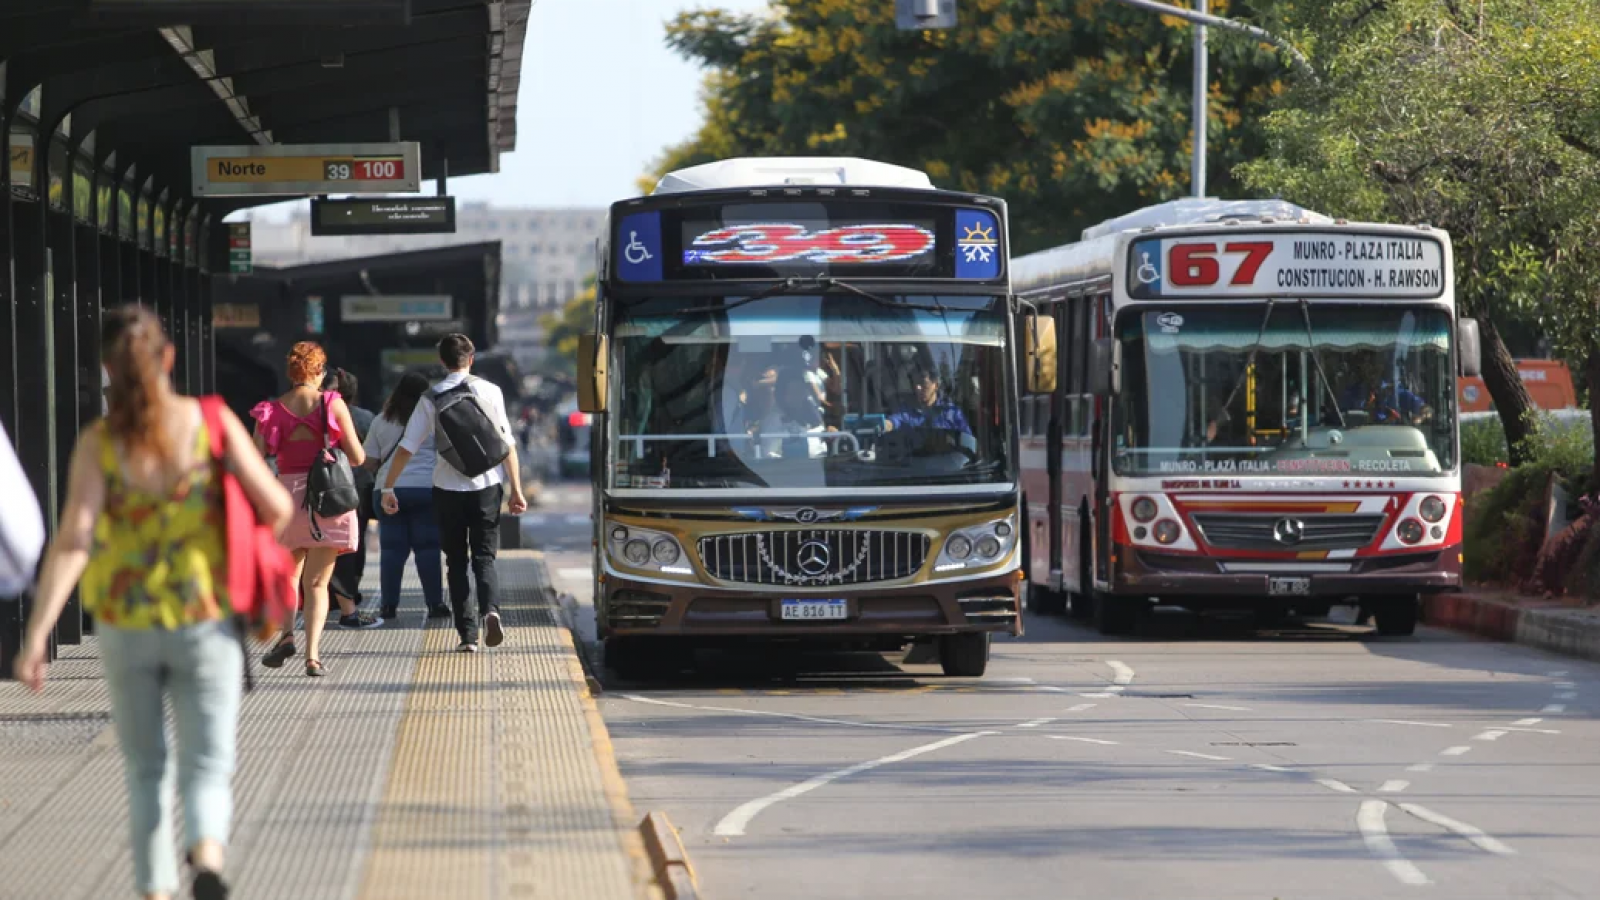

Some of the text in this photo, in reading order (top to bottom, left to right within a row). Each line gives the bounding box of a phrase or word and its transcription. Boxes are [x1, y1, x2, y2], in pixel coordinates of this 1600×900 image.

[218, 161, 395, 180] Norte 39 100
[693, 223, 935, 263] 39
[1293, 241, 1336, 260] MUNRO
[1344, 241, 1383, 260] PLAZA
[1386, 241, 1424, 260] ITALIA
[1167, 240, 1274, 287] 67
[1277, 269, 1365, 288] CONSTITUCION
[1374, 269, 1386, 287] H.
[1389, 269, 1439, 288] RAWSON
[1160, 460, 1197, 472] MUNRO
[1204, 460, 1237, 472] PLAZA
[1239, 460, 1270, 472] ITALIA
[1358, 459, 1411, 472] RECOLETA
[784, 605, 843, 617] AE 816 TT
